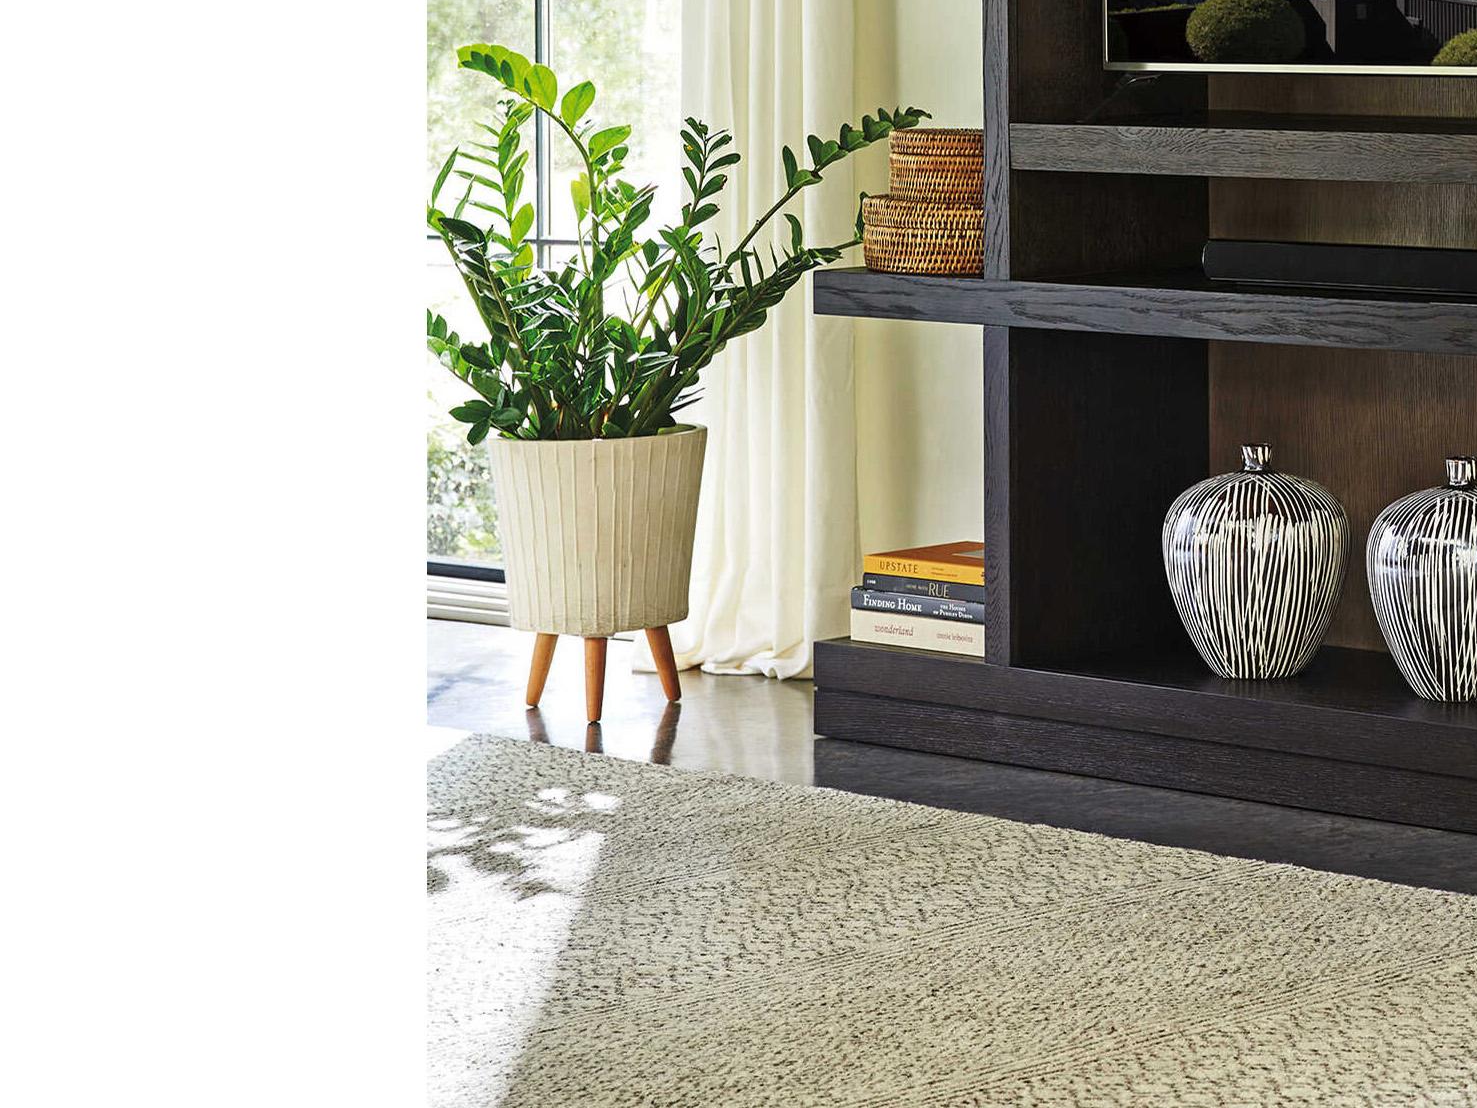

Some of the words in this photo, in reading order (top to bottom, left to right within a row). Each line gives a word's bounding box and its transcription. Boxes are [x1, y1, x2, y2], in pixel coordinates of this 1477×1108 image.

[879, 560, 919, 574] UPSTATE
[928, 582, 951, 598] RUE
[874, 623, 914, 637] wonderland
